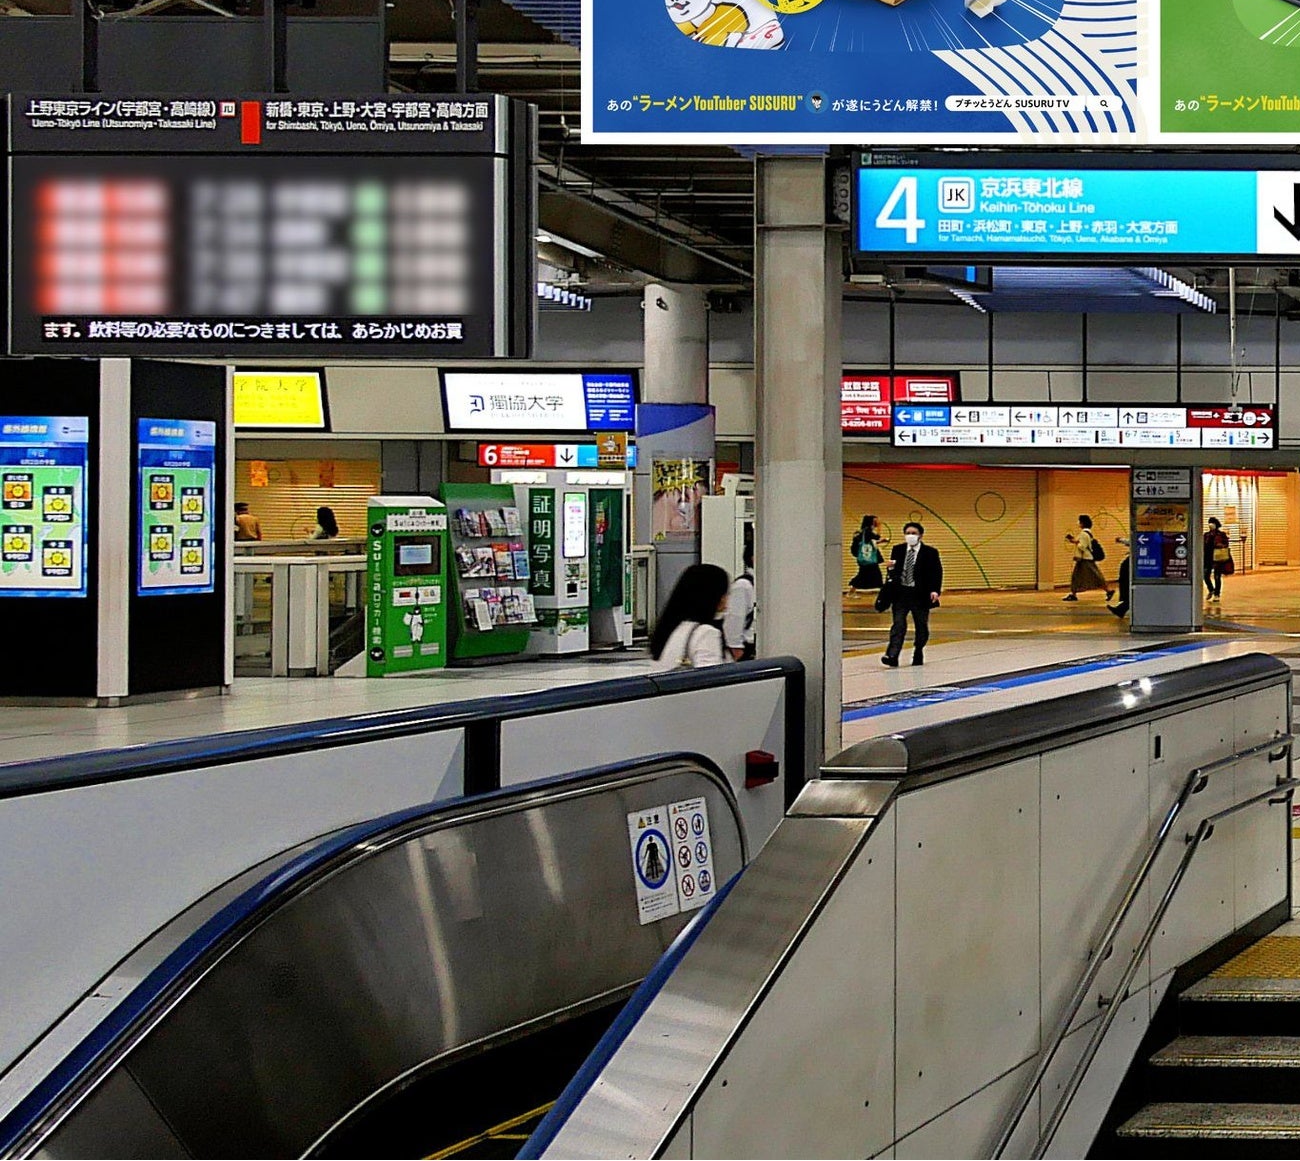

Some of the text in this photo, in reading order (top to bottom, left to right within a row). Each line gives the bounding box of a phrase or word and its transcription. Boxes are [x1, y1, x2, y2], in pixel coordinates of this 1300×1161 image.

[26, 101, 215, 116] 上野東京ライン(宇都宮・高崎線)
[266, 102, 488, 118] 新橋・東京・上野・大宮・宇都宮・高崎方面
[832, 98, 939, 113] が遂にうどん解禁!
[955, 98, 1070, 108] プチッとうどん SUSURU TV
[32, 119, 80, 129] Ueno-Tōkyō
[83, 119, 100, 128] Line
[195, 119, 216, 129] Line)
[266, 120, 276, 130] for
[278, 120, 318, 131] Shimbashi,
[450, 121, 483, 131] Takasaki
[947, 188, 965, 201] JK
[980, 178, 1083, 198] 京浜東北線
[876, 177, 925, 244] 4
[980, 201, 1095, 213] Keihin-Tōhoku Line
[938, 220, 1177, 233] 田町・浜松町・東京・上野・赤羽・大宮方面
[939, 235, 948, 243] for
[44, 322, 462, 340] ます。飲料等の必要なものにつきましては、あらかじめお買
[484, 446, 497, 464] 6
[533, 496, 552, 589] 証明写真
